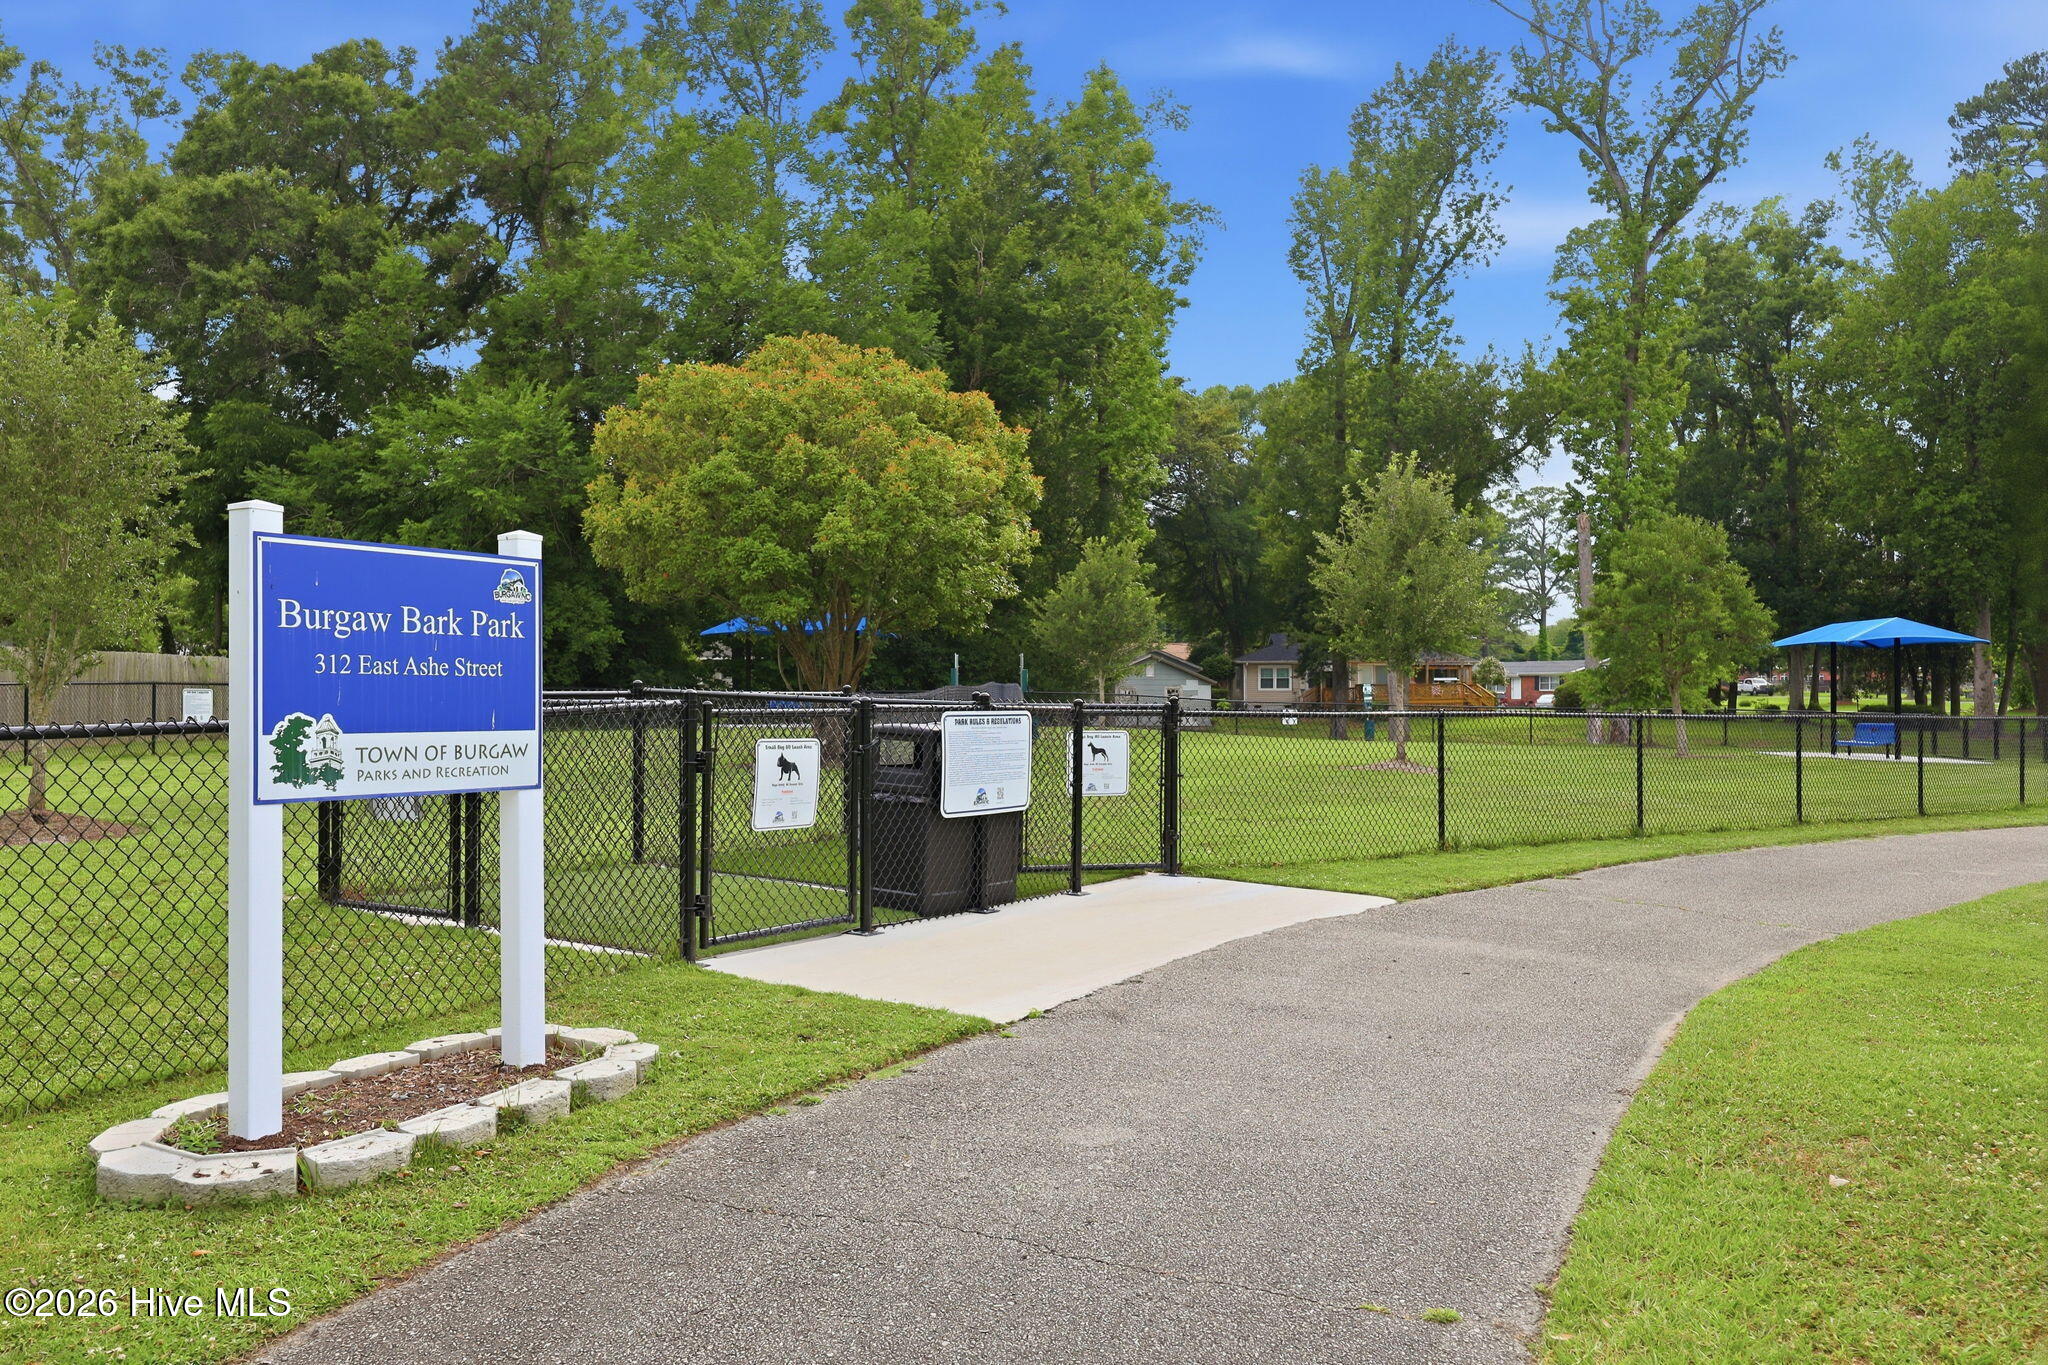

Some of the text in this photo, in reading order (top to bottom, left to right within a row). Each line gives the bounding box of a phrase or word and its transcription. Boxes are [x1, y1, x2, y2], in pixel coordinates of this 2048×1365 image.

[277, 598, 526, 639] Burgaw Bark Park
[314, 653, 504, 677] 312 East Ashe Street
[991, 717, 1022, 725] REGULATIONS
[355, 743, 529, 764] TOWN OF BURGAW
[401, 768, 431, 780] AND
[436, 765, 509, 778] RECREATION
